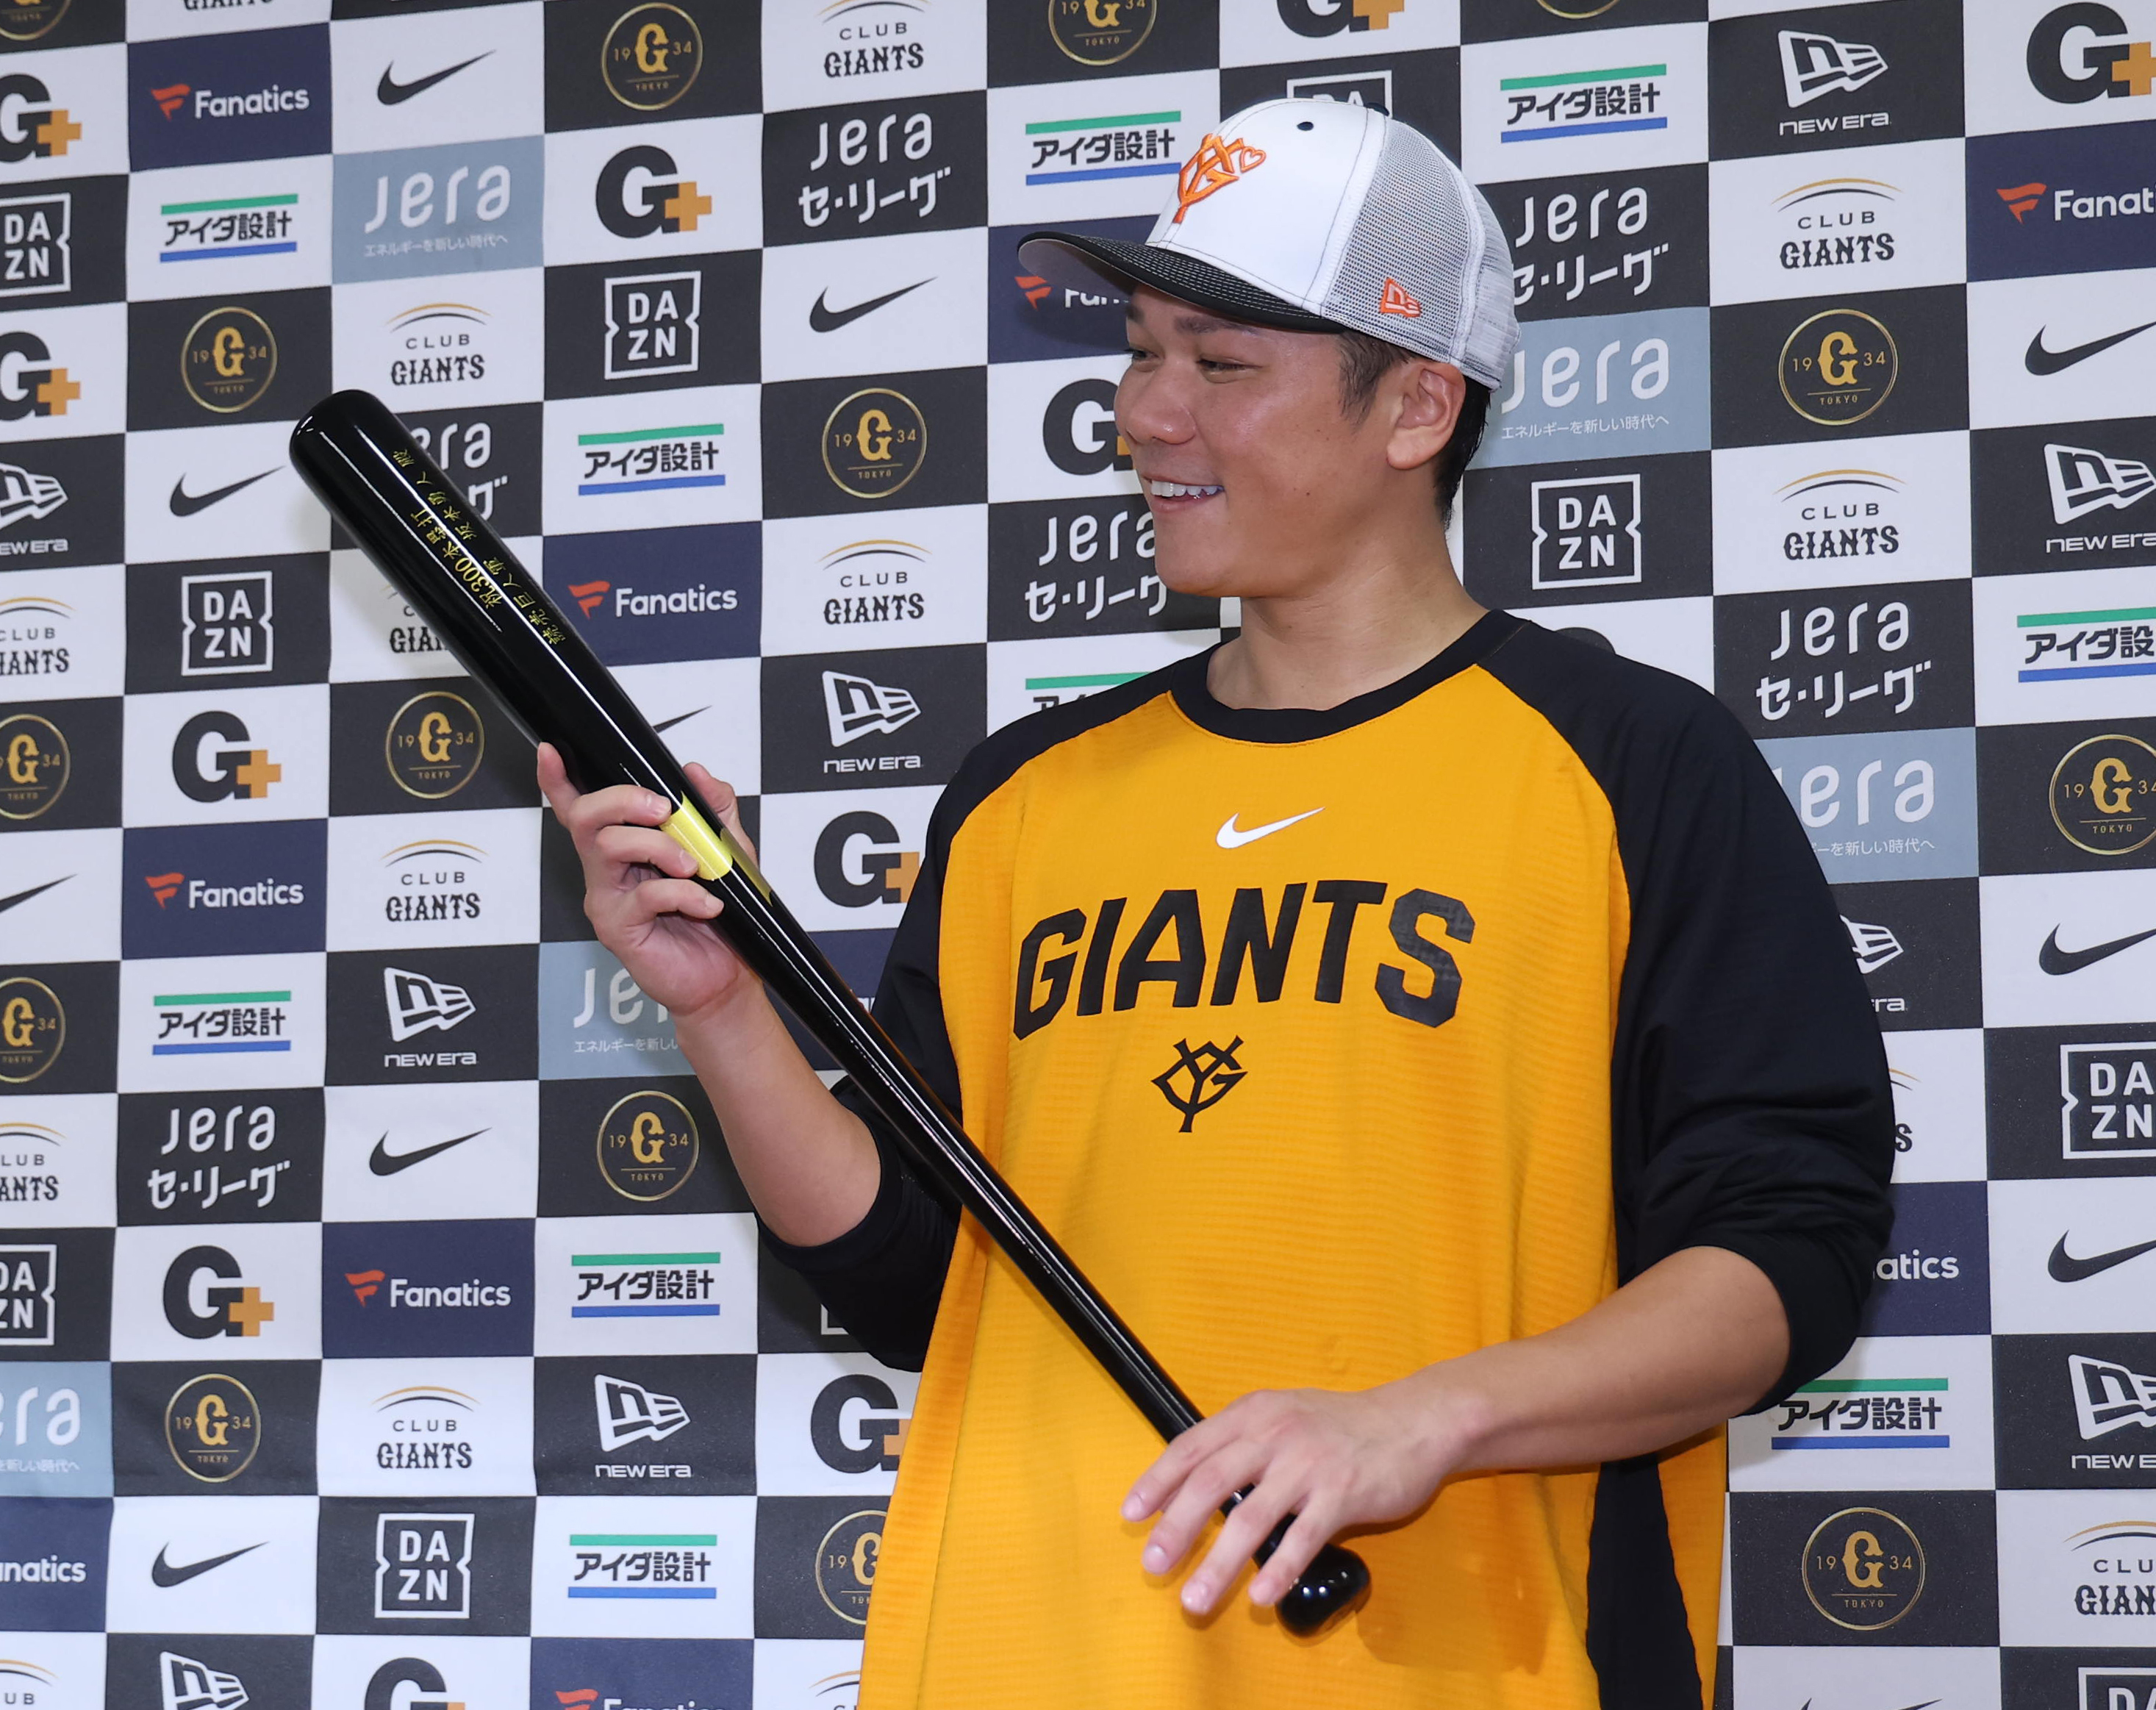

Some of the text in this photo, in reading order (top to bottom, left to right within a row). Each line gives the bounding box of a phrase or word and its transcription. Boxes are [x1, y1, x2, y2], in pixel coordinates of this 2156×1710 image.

[839, 22, 907, 40] CLUB
[615, 24, 692, 73] 19 G 34
[824, 43, 923, 78] GIANTS
[196, 85, 309, 118] Fanatics
[1508, 83, 1660, 124] アイダ設計
[1033, 129, 1174, 168] アイダ設計
[1798, 211, 1874, 229] CLUB
[2054, 187, 2155, 221] Fanat
[166, 212, 290, 245] アイダ設計
[1780, 233, 1894, 269] GIANTS
[212, 327, 244, 376] G
[406, 334, 470, 349] CLUB
[391, 354, 484, 386] GIANTS
[1794, 332, 1885, 385] 19 G 34
[835, 409, 916, 460] 19 G 34
[1502, 414, 1669, 439] エネルギーを新しい時代へ
[585, 442, 717, 478] アイダ設計
[1802, 503, 1879, 520] CLUB
[1783, 526, 1899, 560] GIANTS
[840, 572, 907, 587] CLUB
[616, 584, 737, 617] Fanatics
[823, 593, 924, 625] GIANTS
[2026, 626, 2156, 663] アイダ設
[0, 648, 69, 676] IANTS
[398, 712, 473, 762] 19 G 34
[2090, 758, 2132, 813] G
[2093, 824, 2132, 833] TOKYO
[1813, 840, 1935, 856] ーを新しい時代へ
[189, 879, 304, 908] Fanatics
[401, 872, 465, 885] CLUB
[386, 892, 480, 922] GIANTS
[1013, 880, 1475, 1040] GIANTS
[160, 1009, 284, 1038] アイダ設計
[610, 1112, 688, 1163] 19 G 34
[1, 1154, 44, 1166] LUB
[0, 1176, 58, 1201] ANTS
[1877, 1249, 1959, 1279] atics
[391, 1279, 511, 1307] Fanatics
[579, 1270, 714, 1300] アイダ設計
[176, 1395, 251, 1445] 19 G 34
[393, 1420, 456, 1432] CLUB
[1778, 1398, 1941, 1431] アイダ設計
[377, 1442, 472, 1469] GIANTS
[576, 1553, 709, 1581] アイダ設計
[1817, 1531, 1912, 1588] 19 G 34
[2094, 1559, 2152, 1573] CLU
[2074, 1585, 2156, 1615] GIAN
